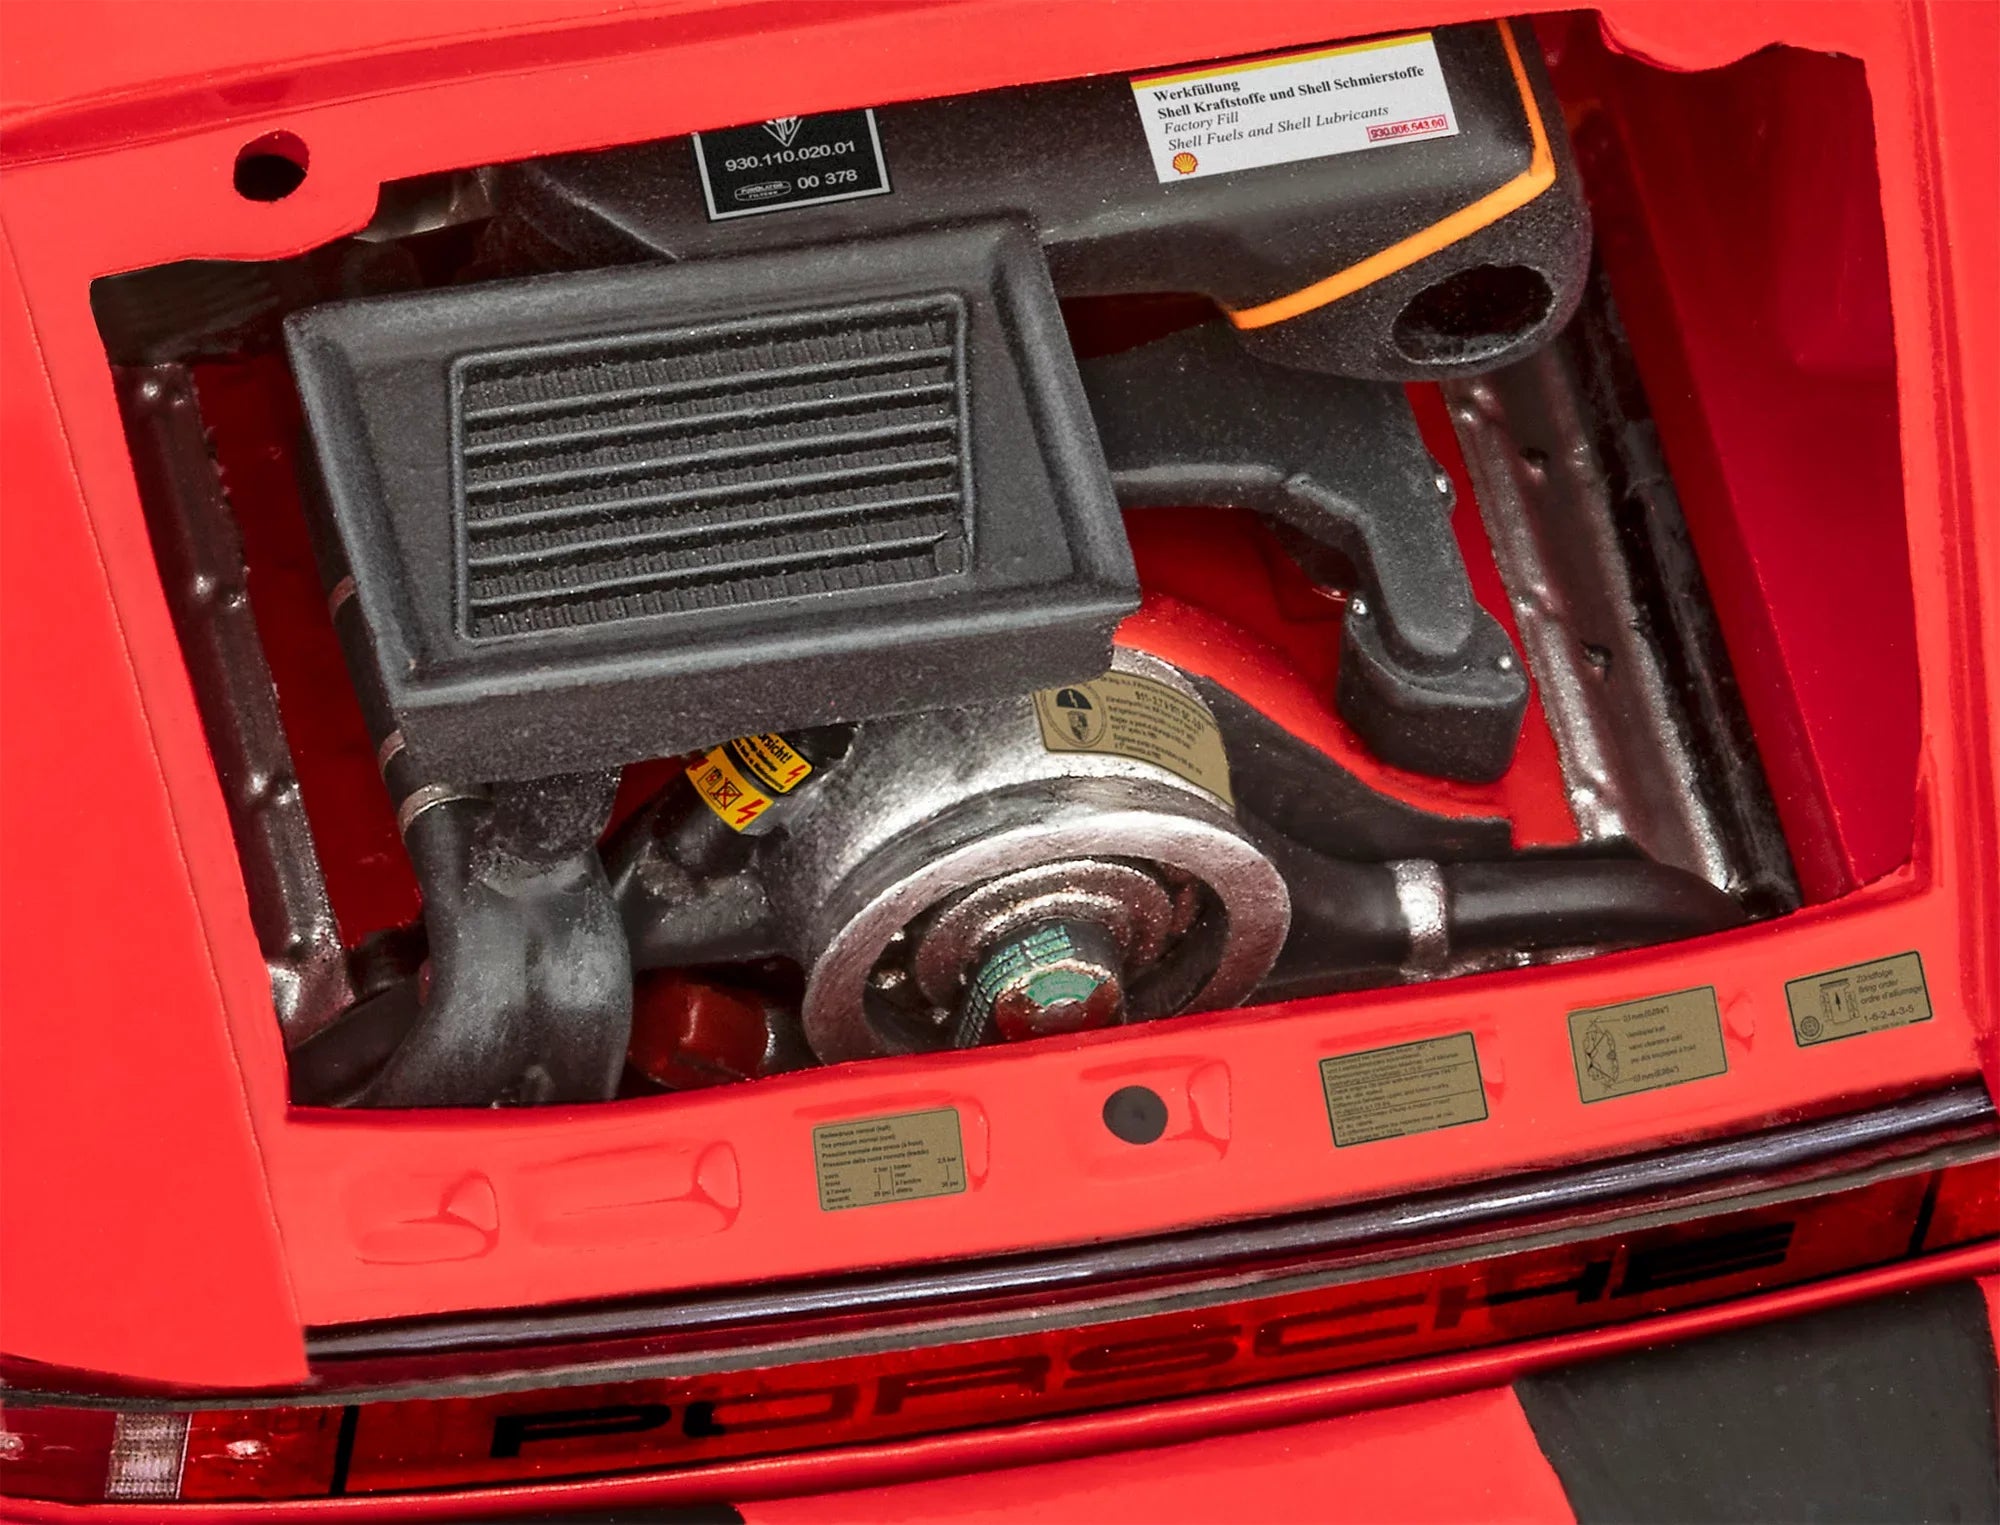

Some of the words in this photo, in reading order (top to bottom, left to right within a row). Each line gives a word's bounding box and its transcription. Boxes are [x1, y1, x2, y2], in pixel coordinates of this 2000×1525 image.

[1153, 82, 1240, 101] Werkfüllung
[1158, 104, 1190, 119] Shell
[1194, 93, 1265, 113] Kraftstoffe
[1269, 87, 1295, 100] und
[1298, 81, 1331, 95] Shell
[1334, 66, 1423, 89] Schmierstoffe
[1165, 119, 1213, 134] Factory
[1217, 111, 1238, 125] Fill
[1169, 135, 1201, 151] Shell
[1207, 129, 1243, 144] Fuels
[1248, 123, 1273, 137] and
[1278, 116, 1310, 132] Shell
[1317, 107, 1388, 126] Lubricants
[725, 140, 855, 171] 930.110.020.01
[797, 175, 819, 189] 00
[825, 169, 858, 184] 378
[1878, 979, 1898, 989] order
[489, 1220, 1796, 1459] PORSCHE
